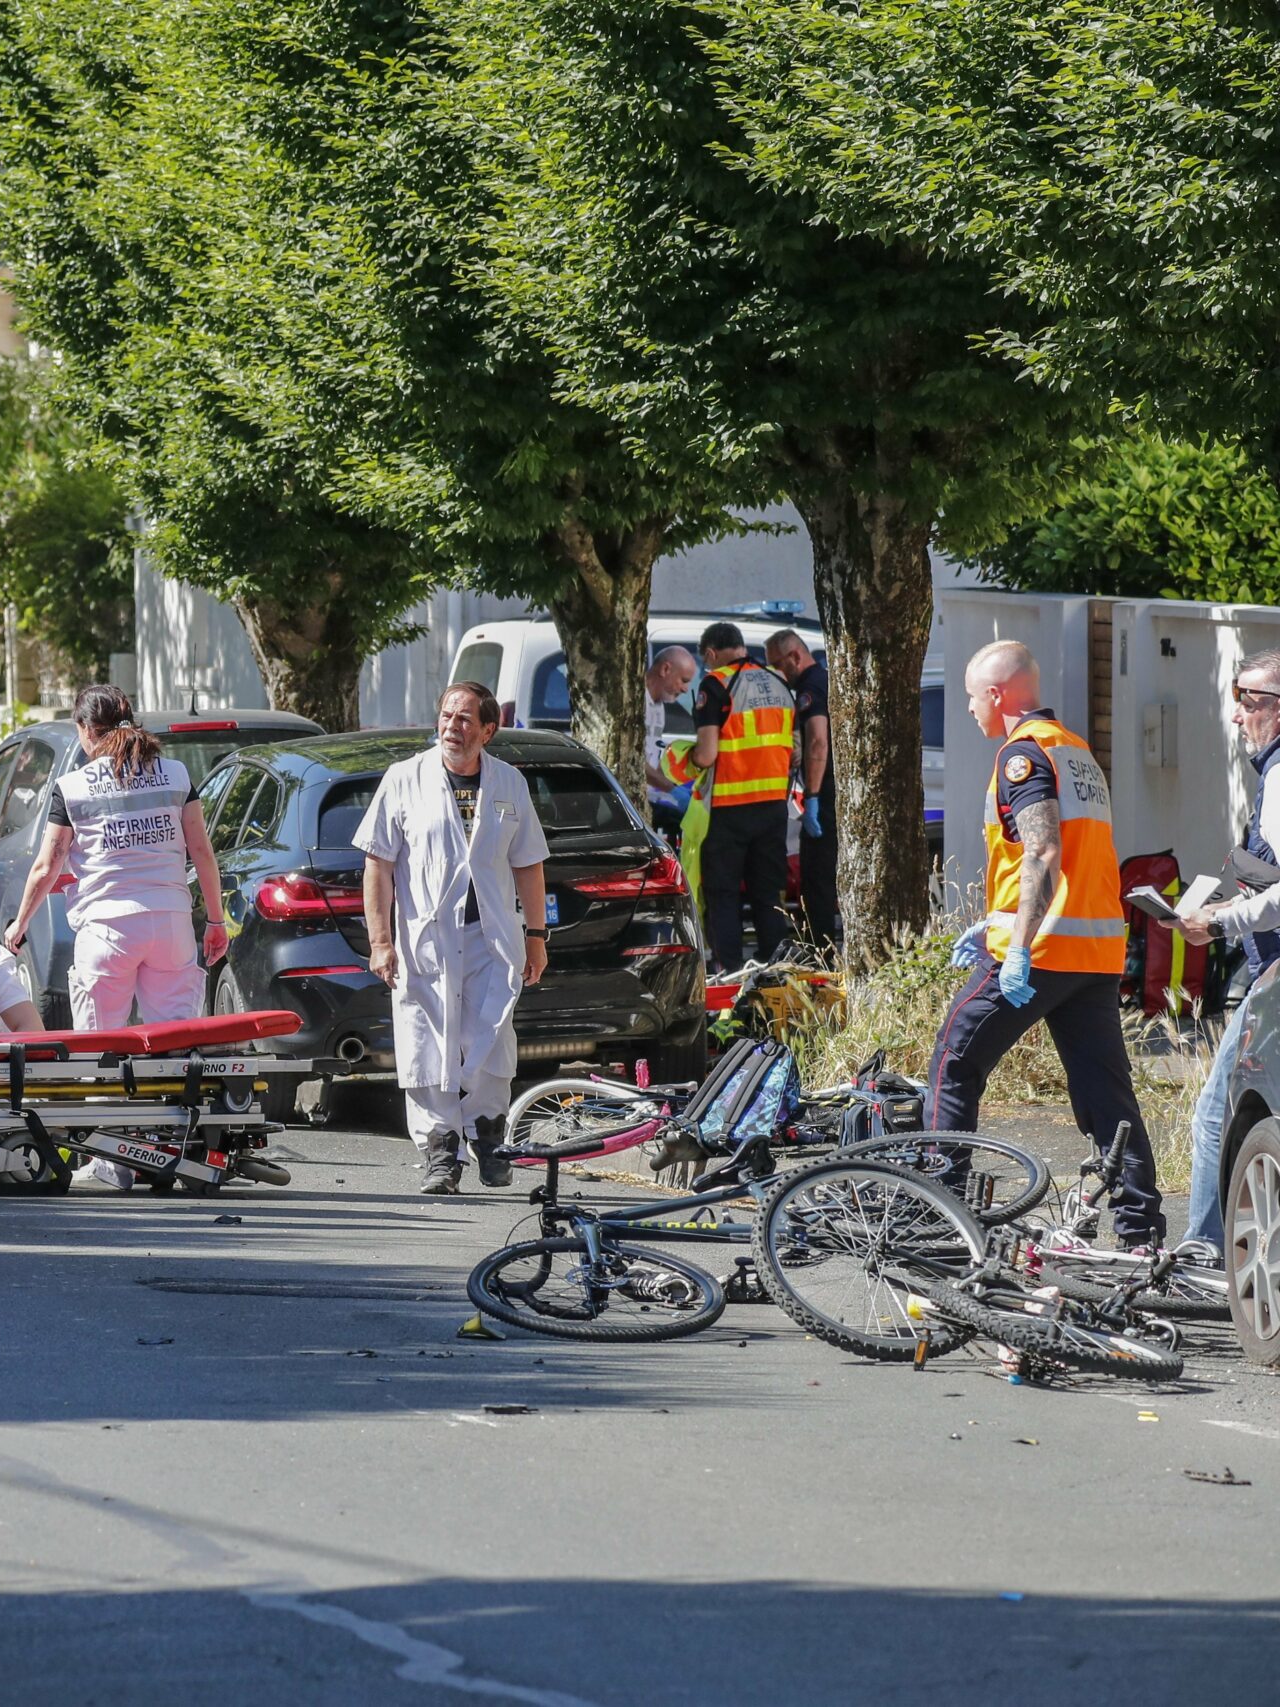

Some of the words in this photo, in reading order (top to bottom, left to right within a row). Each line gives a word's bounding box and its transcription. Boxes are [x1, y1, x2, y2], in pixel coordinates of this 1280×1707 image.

[757, 682, 771, 693] DE
[89, 782, 114, 796] SMUR
[115, 779, 125, 791] LA
[128, 775, 170, 791] ROCHELLE
[104, 815, 172, 837] INFIRMIER
[102, 828, 176, 851] ANESTHESISTE
[232, 1063, 245, 1073] F2
[127, 1146, 167, 1166] FERNO
